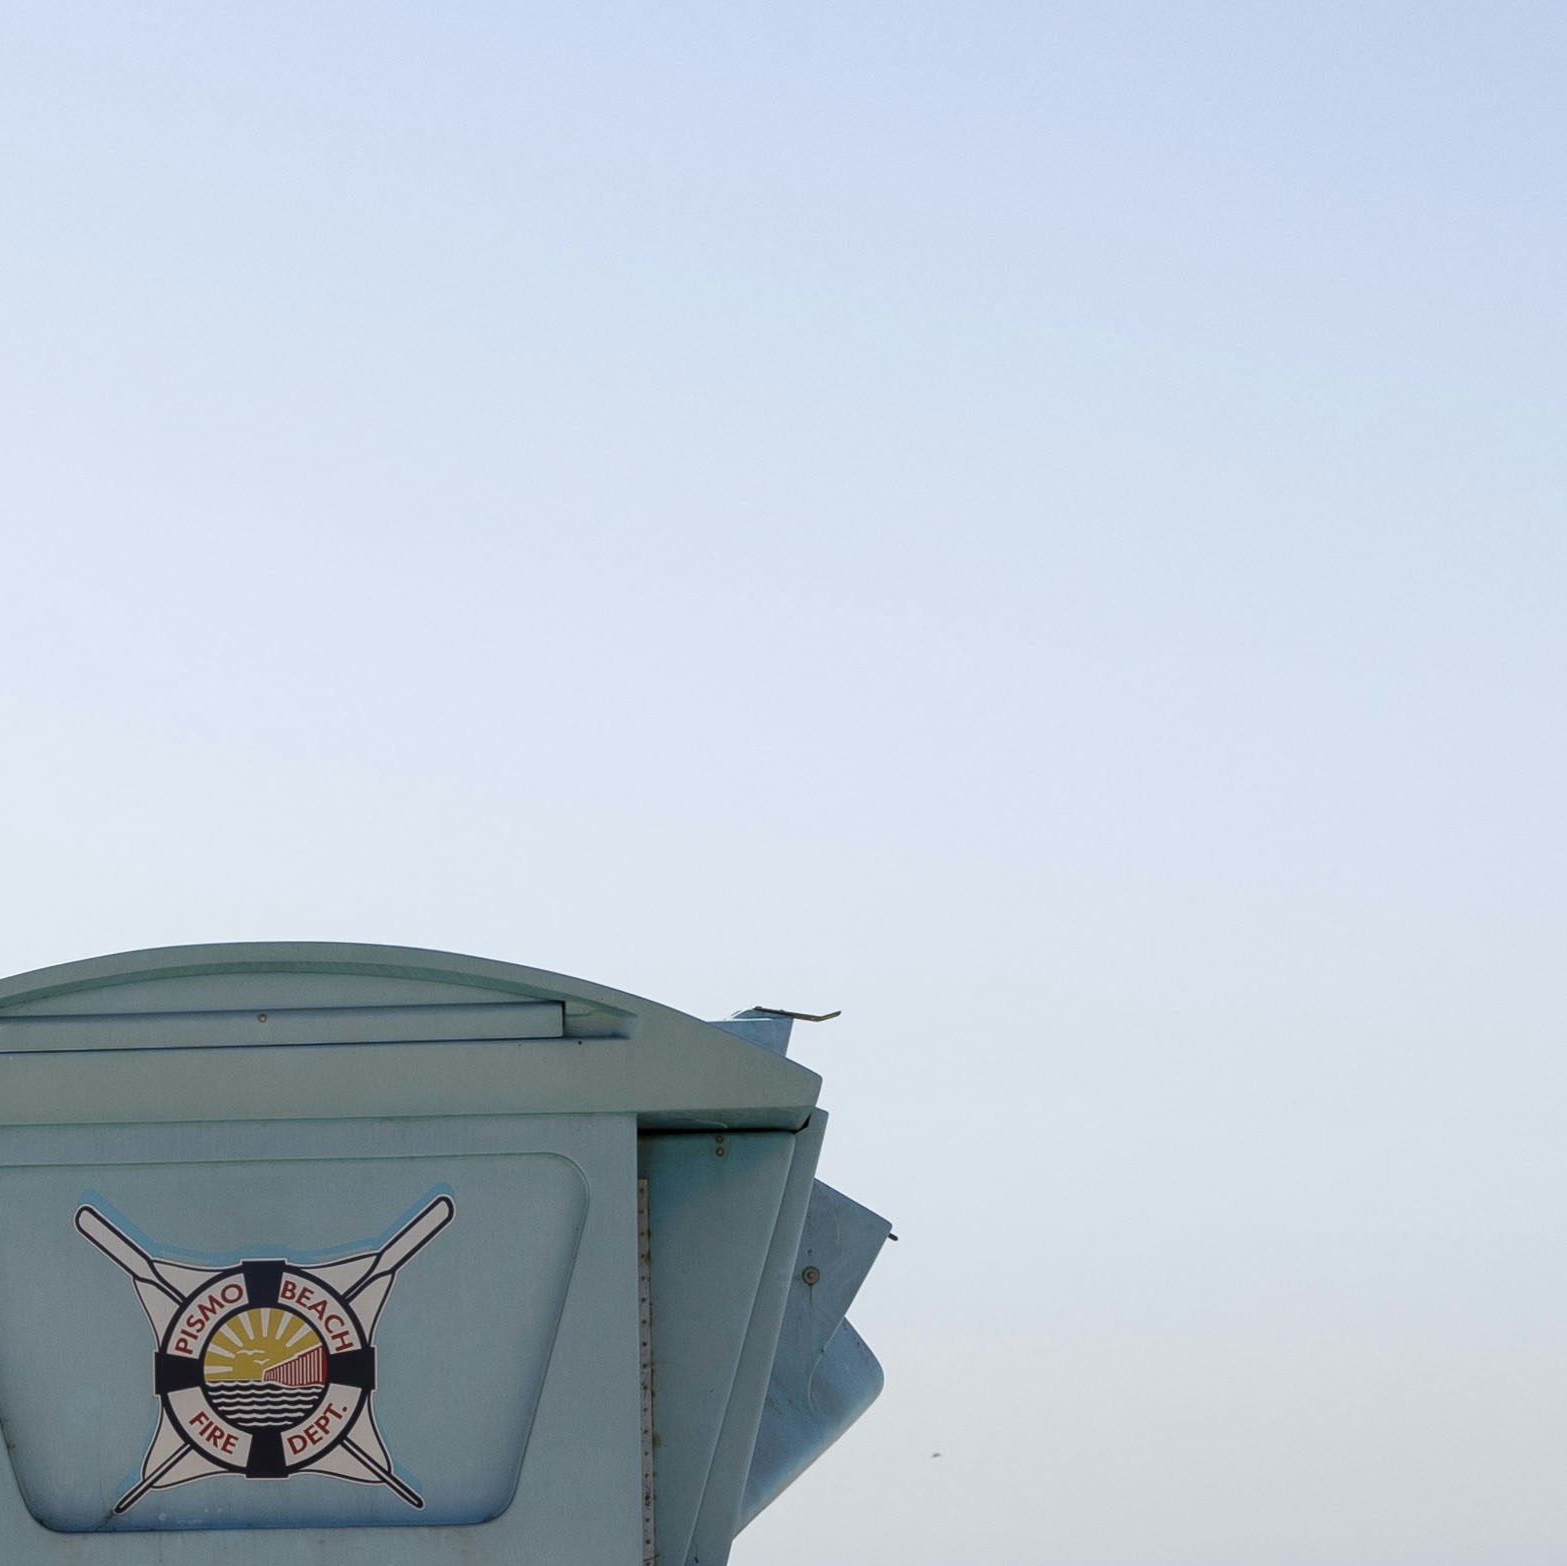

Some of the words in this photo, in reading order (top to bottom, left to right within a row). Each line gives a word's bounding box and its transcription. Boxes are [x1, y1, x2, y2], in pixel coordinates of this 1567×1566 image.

[175, 1283, 244, 1355] PISMO
[280, 1280, 354, 1352] BEACH
[189, 1411, 239, 1454] FIRE
[287, 1403, 348, 1455] DEPT.
